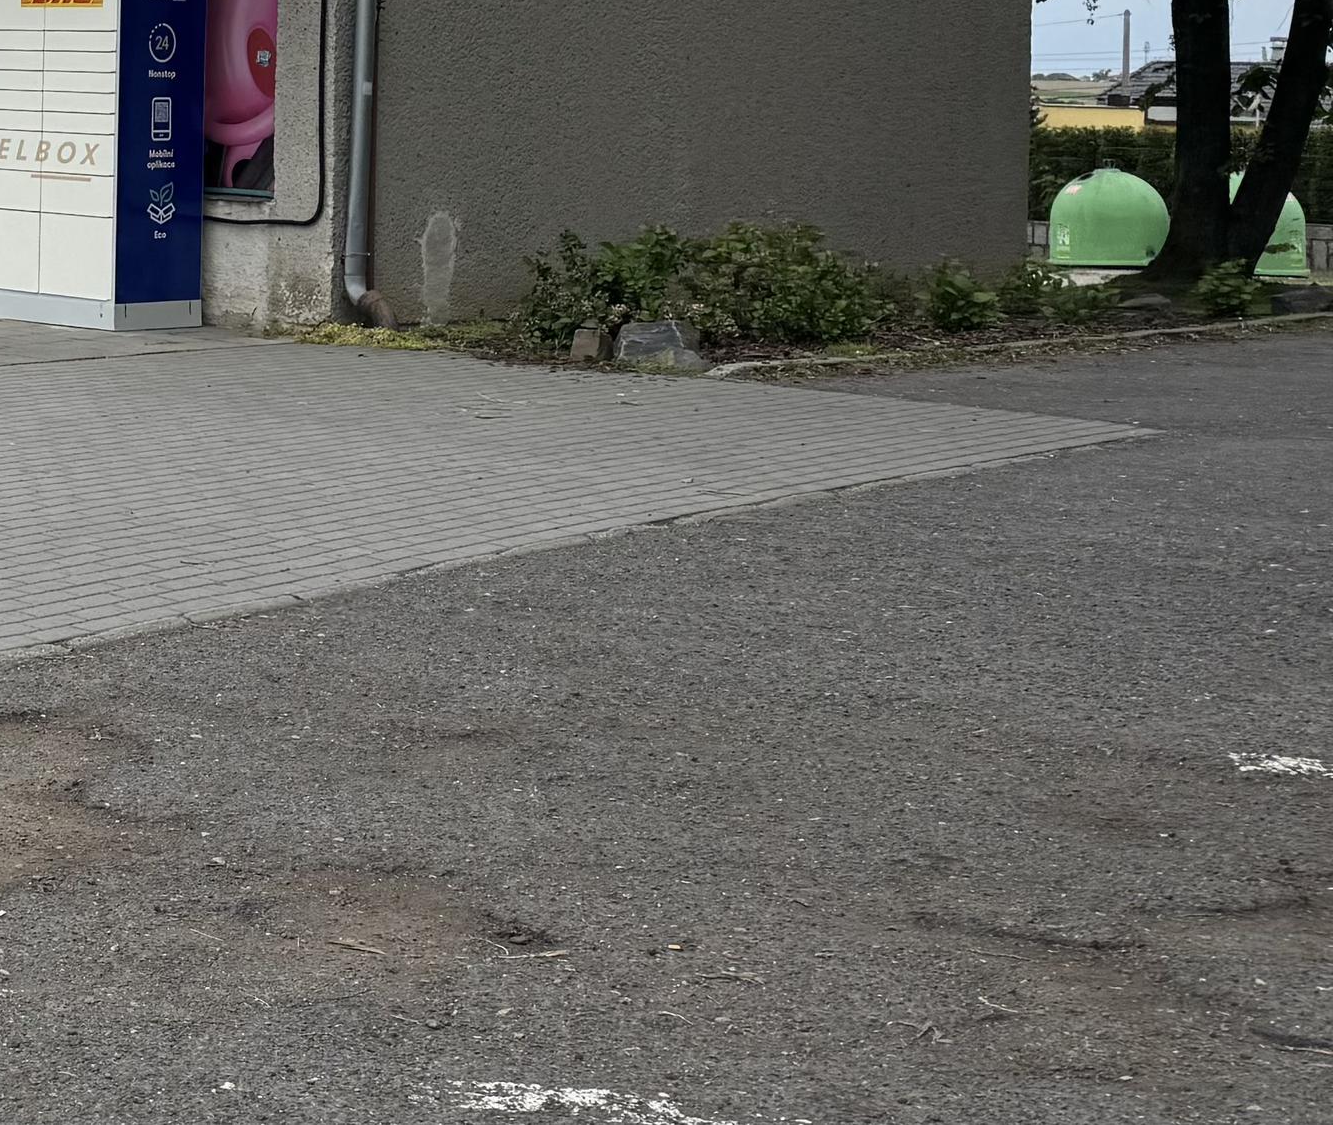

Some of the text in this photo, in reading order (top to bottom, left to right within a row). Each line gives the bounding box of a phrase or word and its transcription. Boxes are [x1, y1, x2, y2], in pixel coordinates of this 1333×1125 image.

[155, 35, 170, 50] 24
[148, 69, 176, 80] Nonstop
[154, 231, 167, 239] Eco
